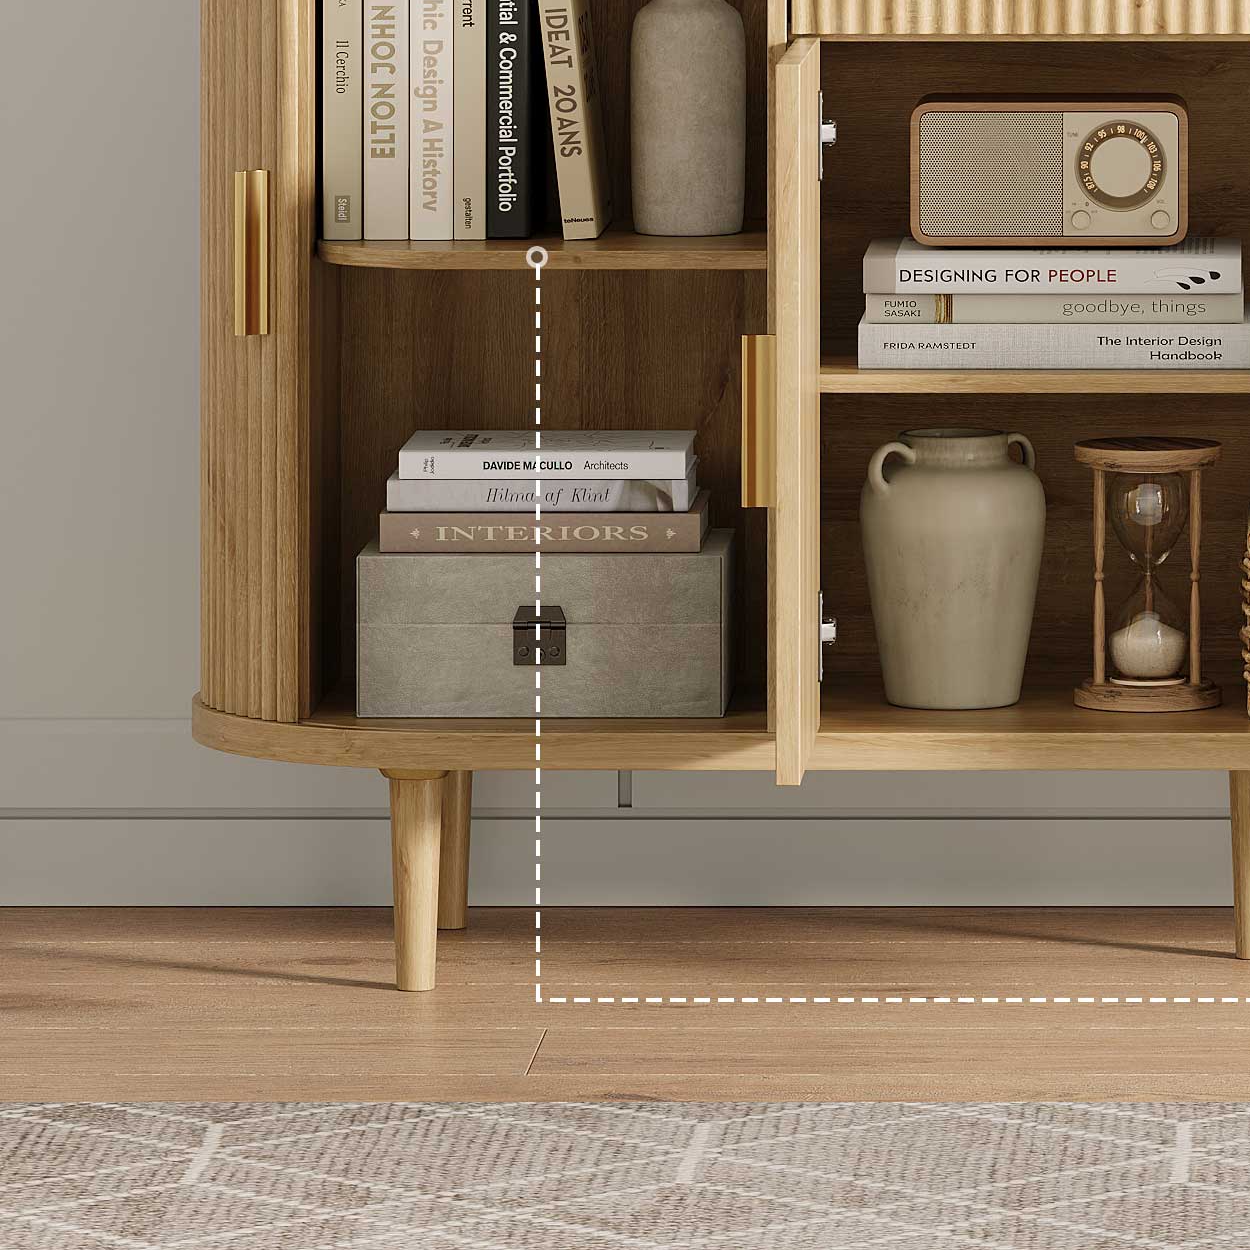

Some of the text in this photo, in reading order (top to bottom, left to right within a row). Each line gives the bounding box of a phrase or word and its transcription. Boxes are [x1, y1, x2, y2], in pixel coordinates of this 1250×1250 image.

[499, 31, 517, 45] &
[335, 51, 350, 94] Cerchio
[413, 40, 444, 112] Design
[370, 5, 397, 159] ELTON JOHN
[544, 7, 583, 158] IDEAT 20 ANS
[498, 47, 519, 143] Commercial
[422, 119, 444, 135] A
[1116, 125, 1126, 134] 98
[1097, 129, 1107, 139] 95
[1133, 128, 1146, 140] 100
[1084, 142, 1094, 152] 92
[1146, 141, 1158, 154] 103
[1080, 160, 1089, 170] 90
[498, 146, 519, 212] Portfolio
[1146, 177, 1158, 190] 108
[462, 197, 473, 230] gestalten
[899, 268, 1118, 284] DESIGNING FOR PEOPLE
[883, 300, 918, 308] FUMIO
[1062, 299, 1207, 317] goodbye, things
[883, 309, 922, 318] SASAKI
[883, 342, 977, 350] FRIDA RAMSTEDT
[1096, 336, 1223, 348] The Interior Design
[1149, 350, 1223, 361] Handbook
[482, 460, 629, 470] DAVIDE MACULLO Architects
[485, 487, 611, 507] Hilma af Klint
[434, 524, 649, 542] INTERIORS
